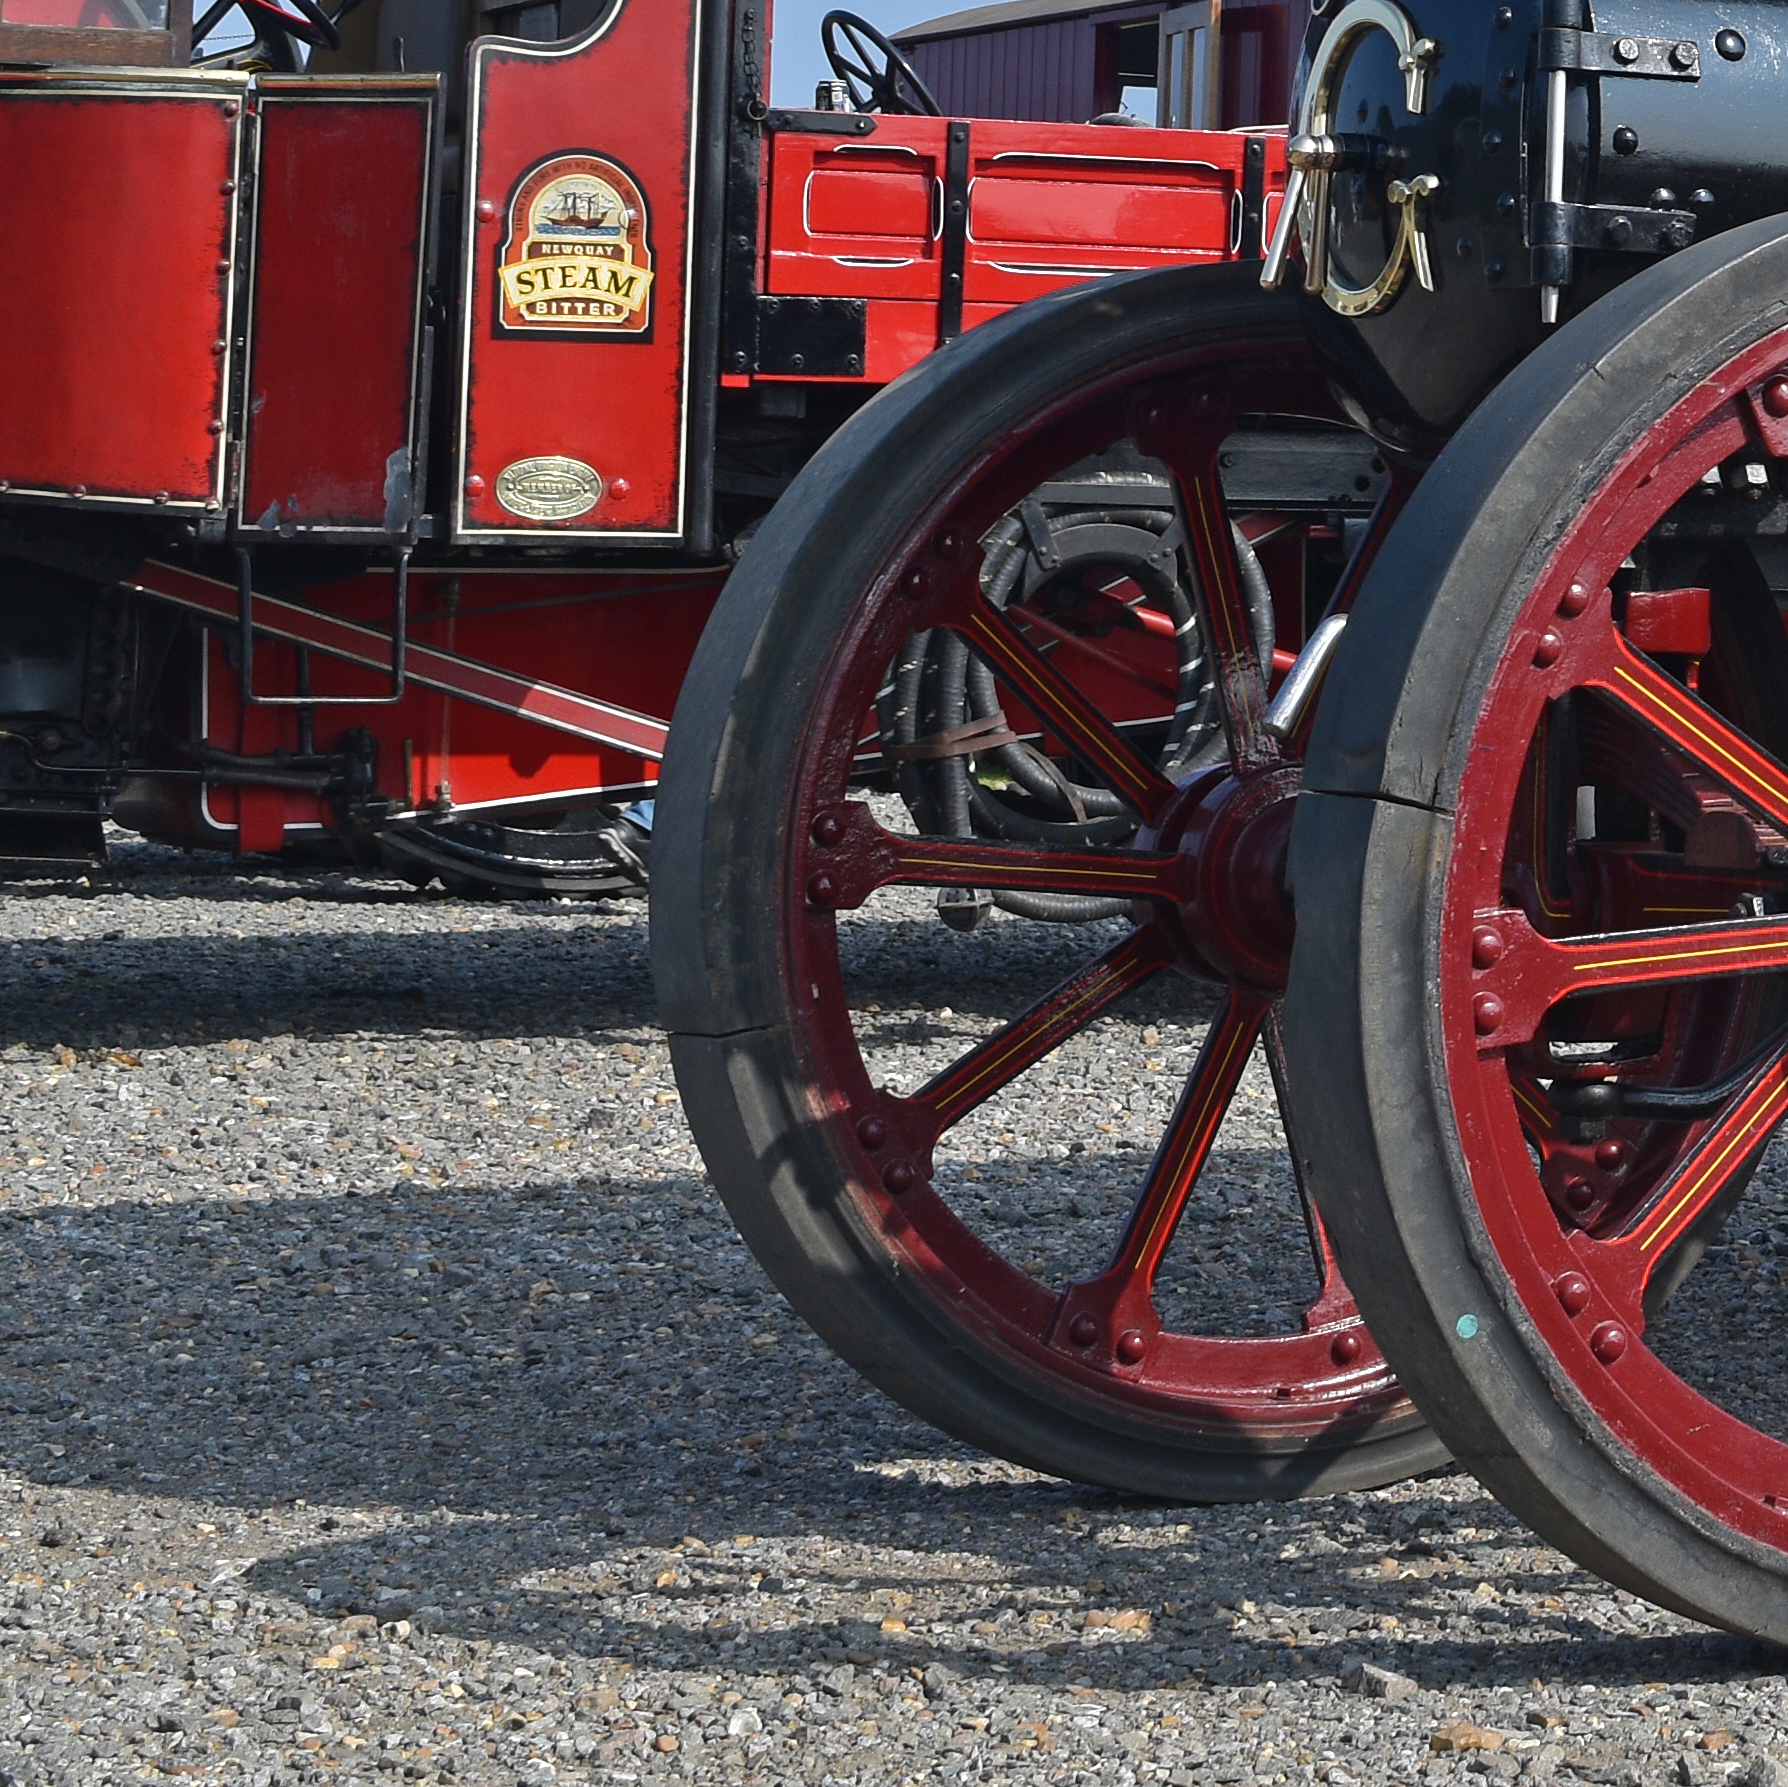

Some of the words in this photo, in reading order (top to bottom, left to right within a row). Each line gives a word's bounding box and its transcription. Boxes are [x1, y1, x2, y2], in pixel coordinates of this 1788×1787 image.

[541, 244, 615, 256] NEWQUAY
[516, 266, 637, 297] STEAM
[535, 301, 617, 316] BITTER
